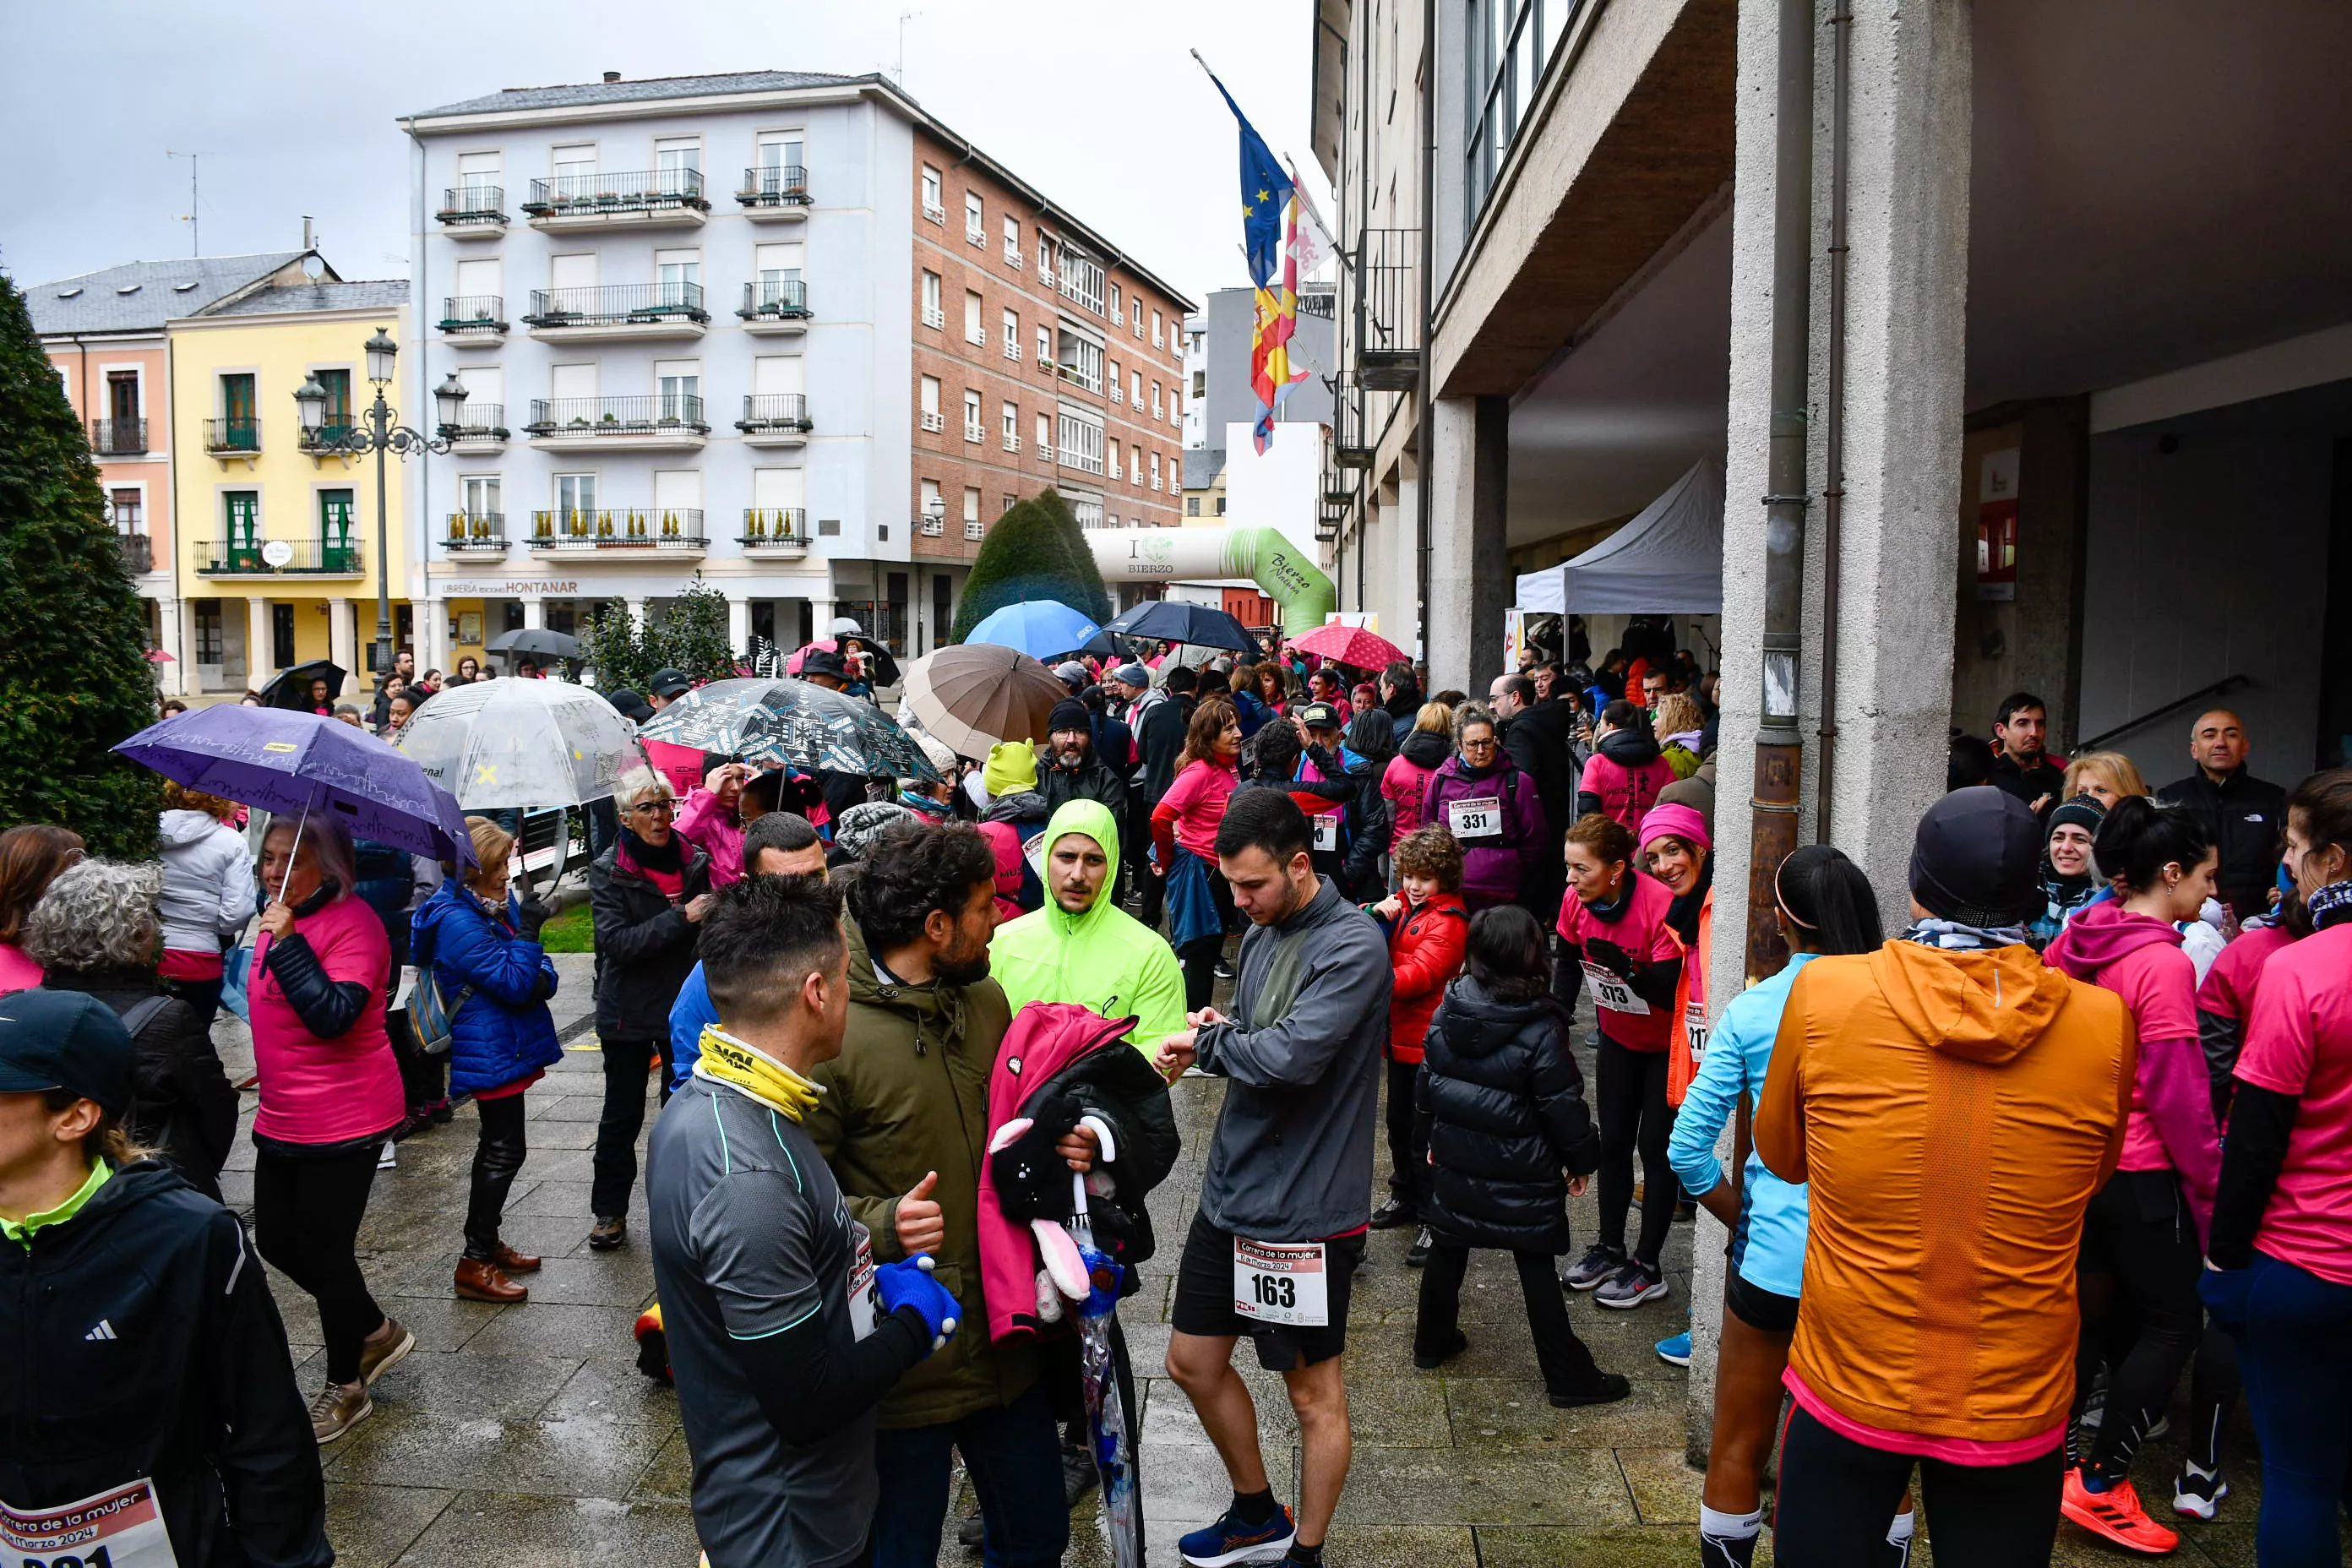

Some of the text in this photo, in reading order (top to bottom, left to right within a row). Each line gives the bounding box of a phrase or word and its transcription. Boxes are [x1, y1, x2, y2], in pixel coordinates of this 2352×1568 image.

[1129, 539, 1139, 558] I
[1129, 564, 1173, 574] BIERZO
[1271, 553, 1309, 588] Bierzo
[506, 581, 578, 593] HONTANAR
[1462, 813, 1487, 829] 331
[1598, 982, 1629, 1004] 373
[1690, 1026, 1707, 1050] 217
[1241, 1242, 1264, 1256] Carrera
[1266, 1250, 1276, 1258] de
[1287, 1250, 1316, 1261] mujer
[1251, 1258, 1271, 1268] Marzo
[853, 1279, 861, 1289] de
[1252, 1273, 1296, 1309] 163
[0, 1492, 139, 1533] Carrera de la mujer
[15, 1537, 56, 1549] Marzo
[58, 1527, 94, 1545] 2024
